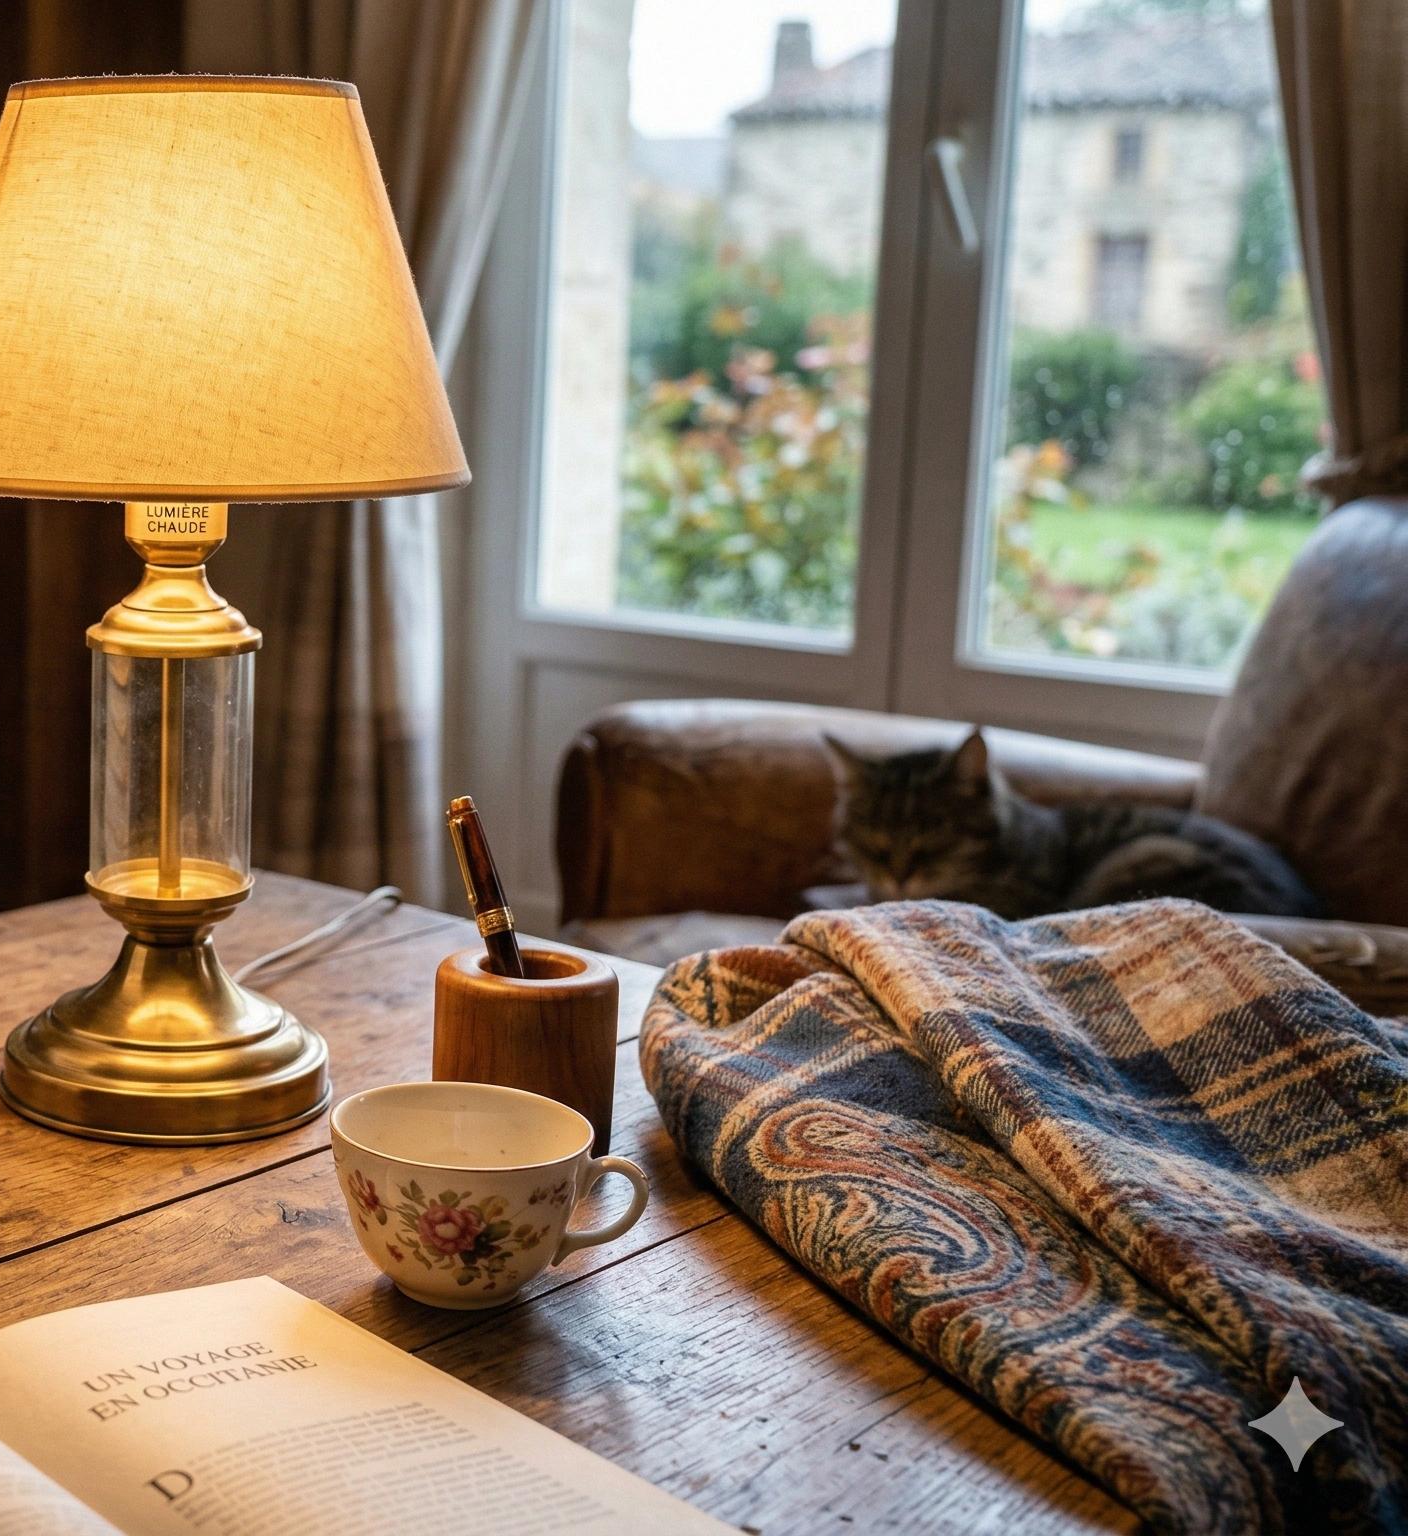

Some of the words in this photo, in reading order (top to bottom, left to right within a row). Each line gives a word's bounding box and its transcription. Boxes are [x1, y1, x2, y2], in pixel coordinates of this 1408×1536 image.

[146, 503, 209, 518] LUMIÈRE
[147, 521, 207, 533] CHAUDE
[82, 1367, 136, 1394] UN
[137, 1341, 273, 1377] VOYAGE
[88, 1392, 140, 1422] EN
[142, 1354, 318, 1400] OCCITANIE
[143, 1468, 194, 1502] D
